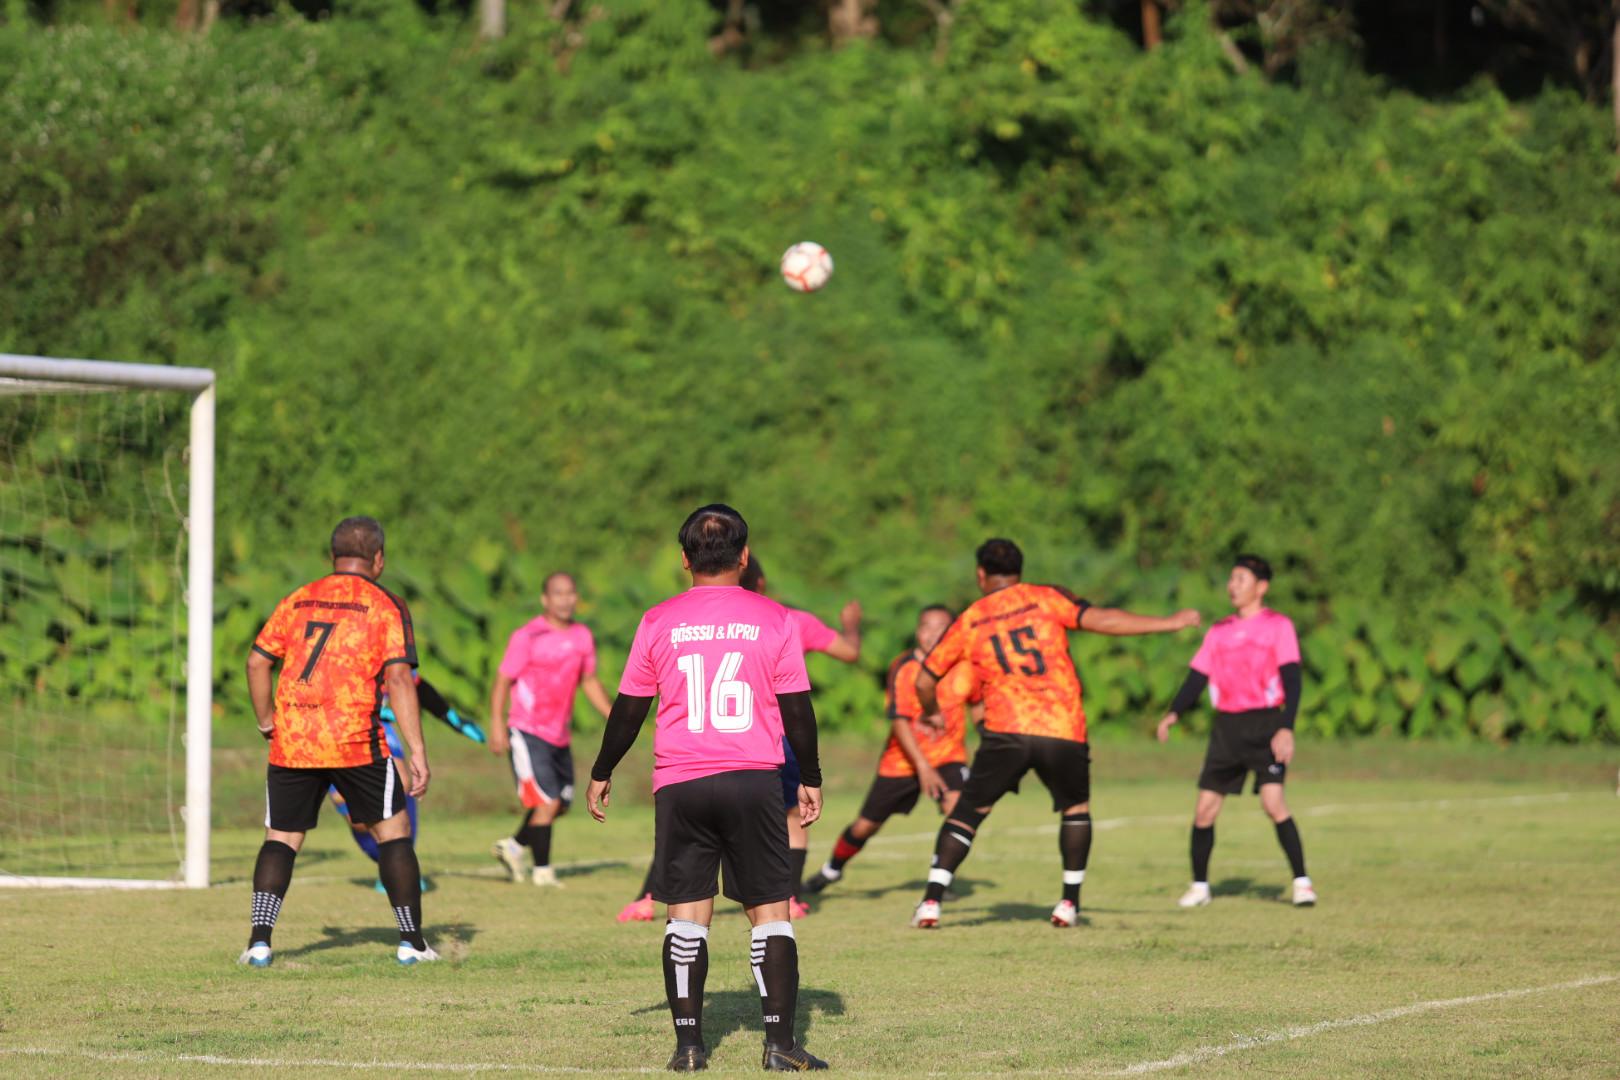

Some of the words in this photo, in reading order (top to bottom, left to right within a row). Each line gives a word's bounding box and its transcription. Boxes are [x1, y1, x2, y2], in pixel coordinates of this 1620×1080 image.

[298, 621, 336, 684] 7
[716, 625, 725, 639] &
[726, 623, 760, 641] KPRU
[989, 625, 1046, 677] 15
[677, 652, 754, 733] 16
